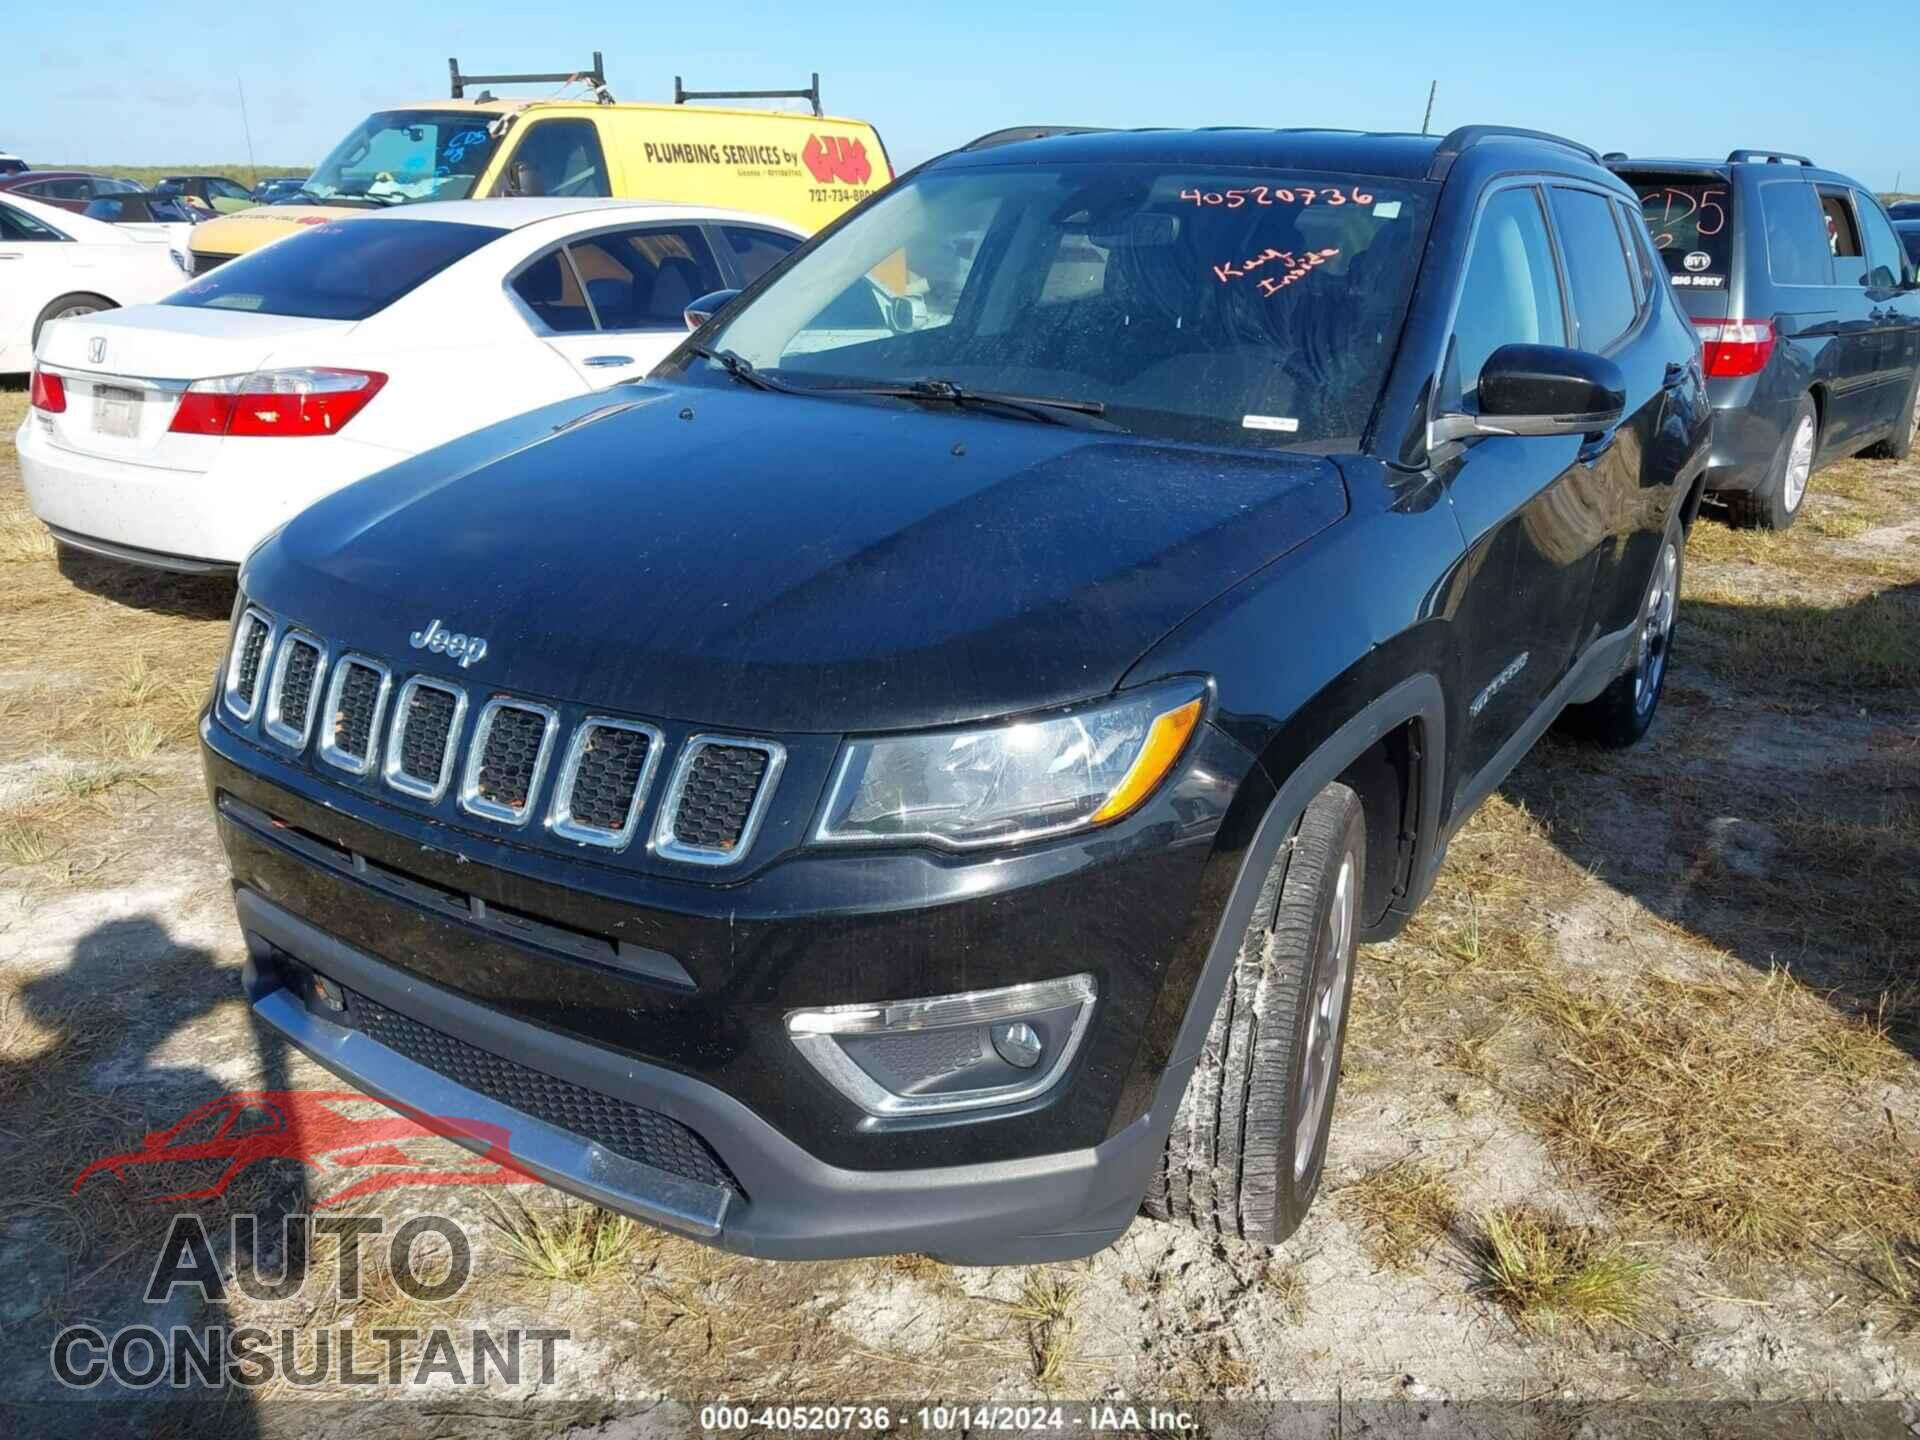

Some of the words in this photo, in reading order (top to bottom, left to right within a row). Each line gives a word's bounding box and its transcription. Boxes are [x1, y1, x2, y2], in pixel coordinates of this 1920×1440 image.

[643, 141, 721, 164] PLUMBING
[722, 143, 781, 165] SERVICES
[783, 148, 798, 167] by
[1180, 186, 1374, 208] 40520736
[409, 619, 488, 668] Jeep
